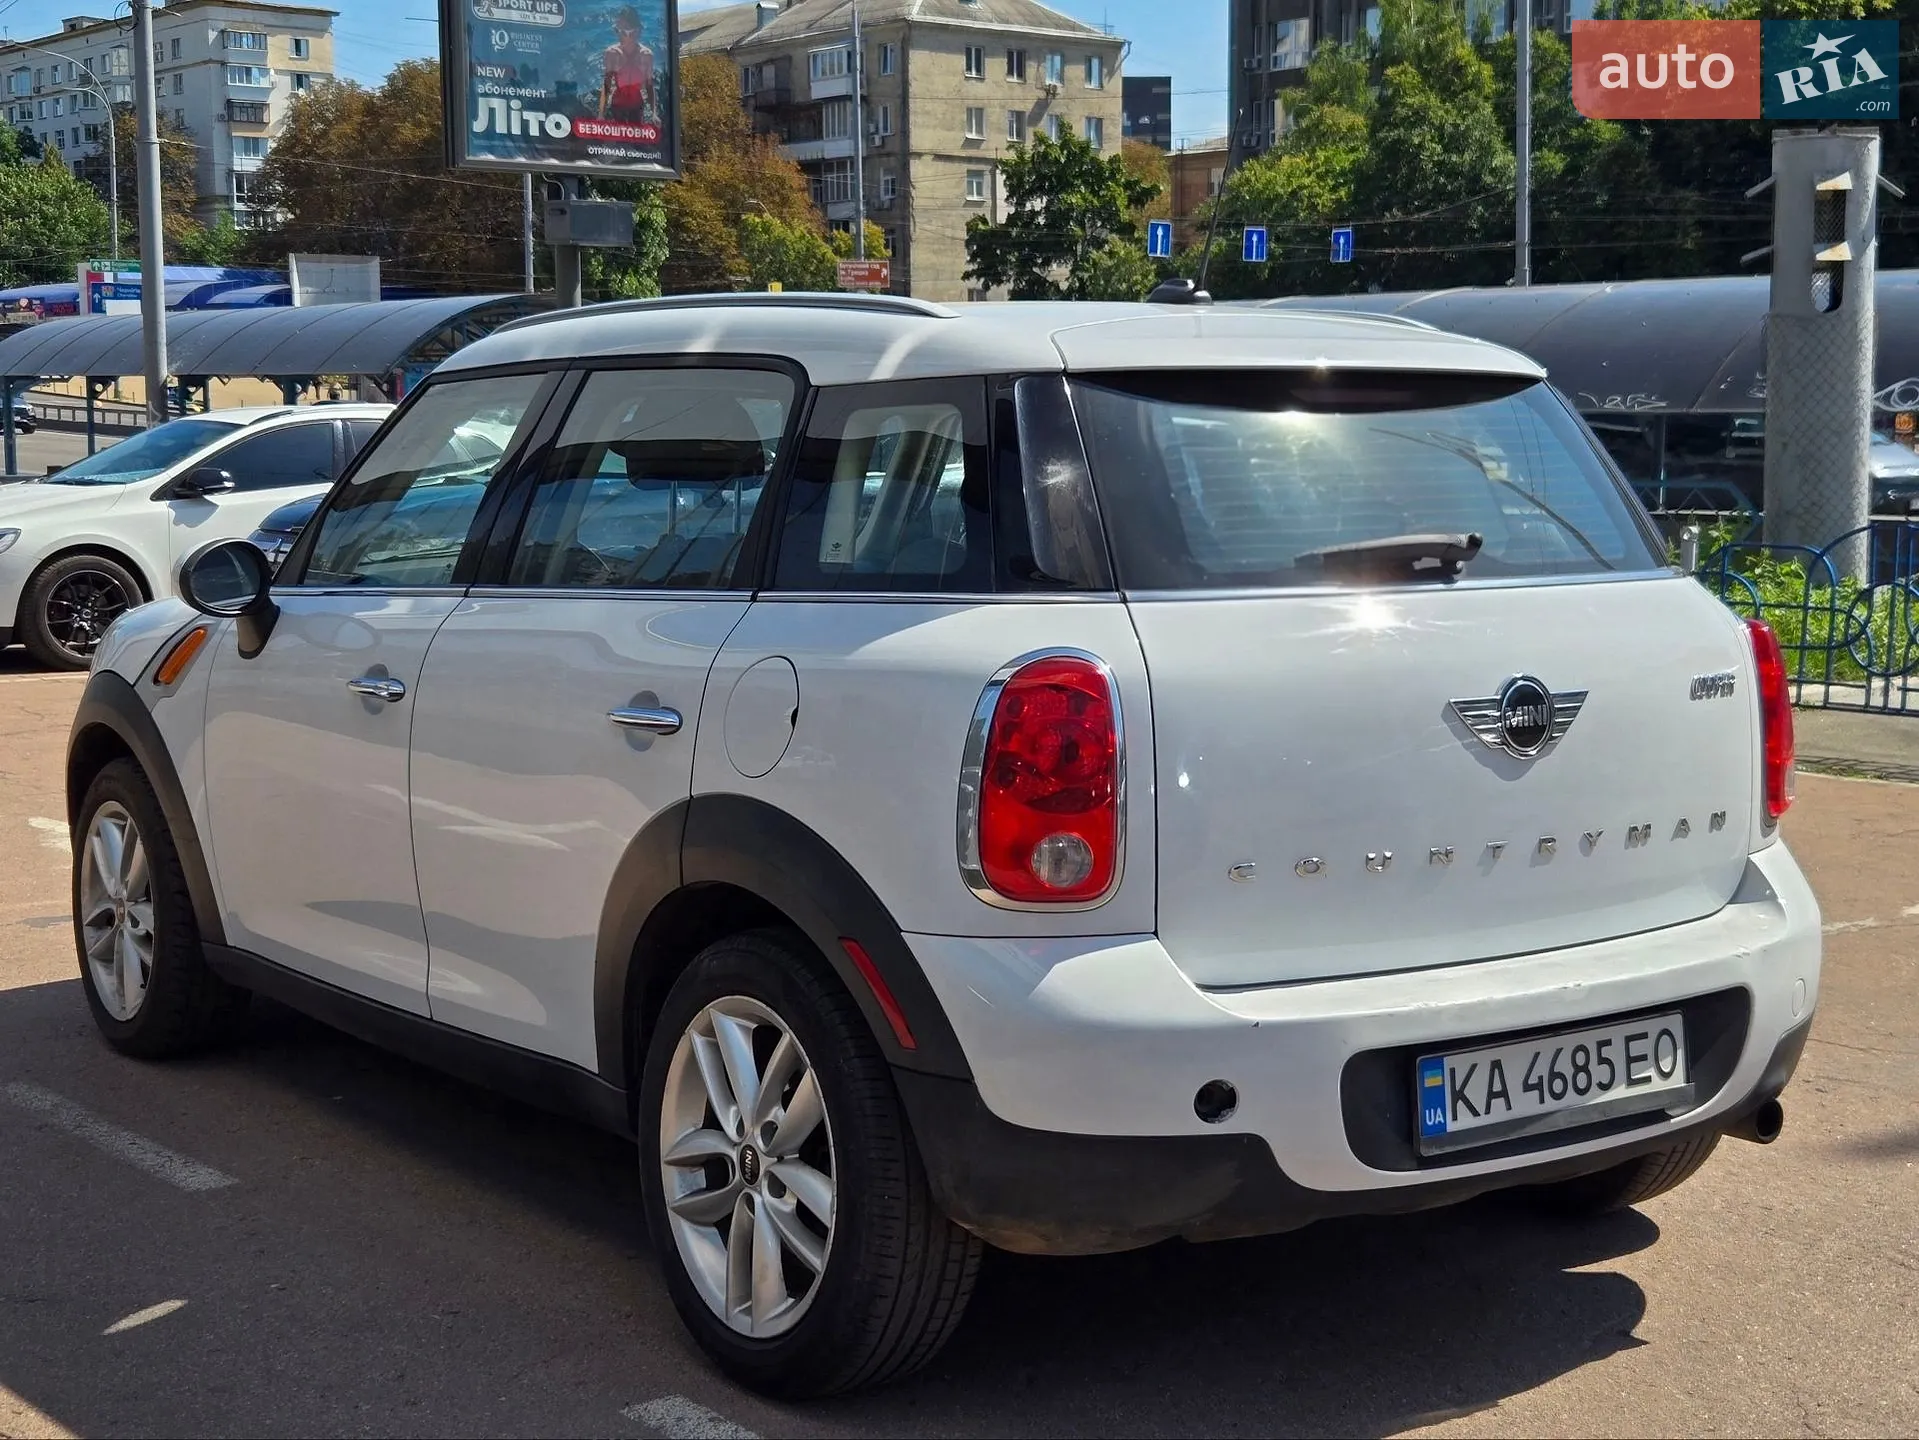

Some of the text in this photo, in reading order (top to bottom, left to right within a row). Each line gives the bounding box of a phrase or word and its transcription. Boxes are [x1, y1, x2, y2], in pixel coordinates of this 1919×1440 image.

[498, 0, 558, 13] SPORT LIFE
[513, 40, 541, 49] CENTER
[477, 66, 506, 79] NEW
[477, 82, 547, 98] абонемент
[472, 97, 572, 139] Літо
[579, 123, 657, 140] БЕЗКОШТОВНО
[587, 146, 626, 157] ОТРИМАЙ
[1504, 704, 1547, 729] MINI
[1227, 809, 1727, 884] COUNTRYMAN
[1449, 1027, 1678, 1122] KA 4685 EO
[1425, 1108, 1445, 1126] UA
[745, 1150, 753, 1180] MINI
